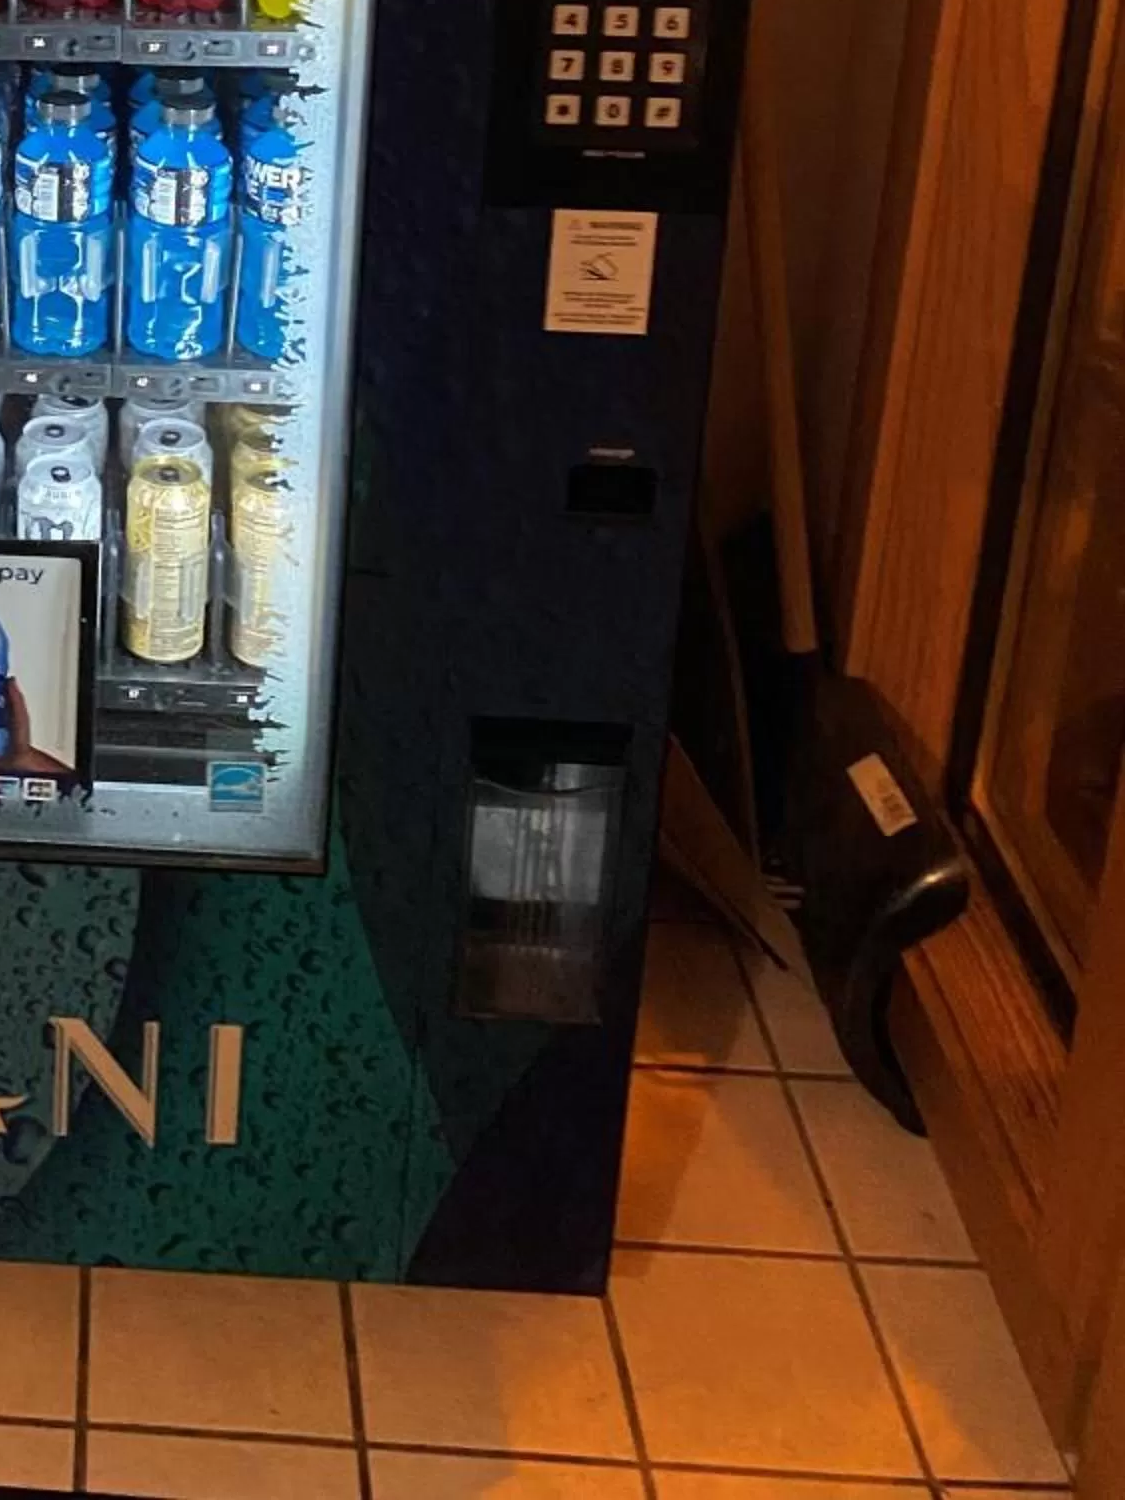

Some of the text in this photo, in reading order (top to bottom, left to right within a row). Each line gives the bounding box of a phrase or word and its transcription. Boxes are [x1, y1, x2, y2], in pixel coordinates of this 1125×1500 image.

[565, 13, 679, 31] 4 5 6
[561, 57, 675, 75] 7 8 9
[606, 103, 620, 119] 0
